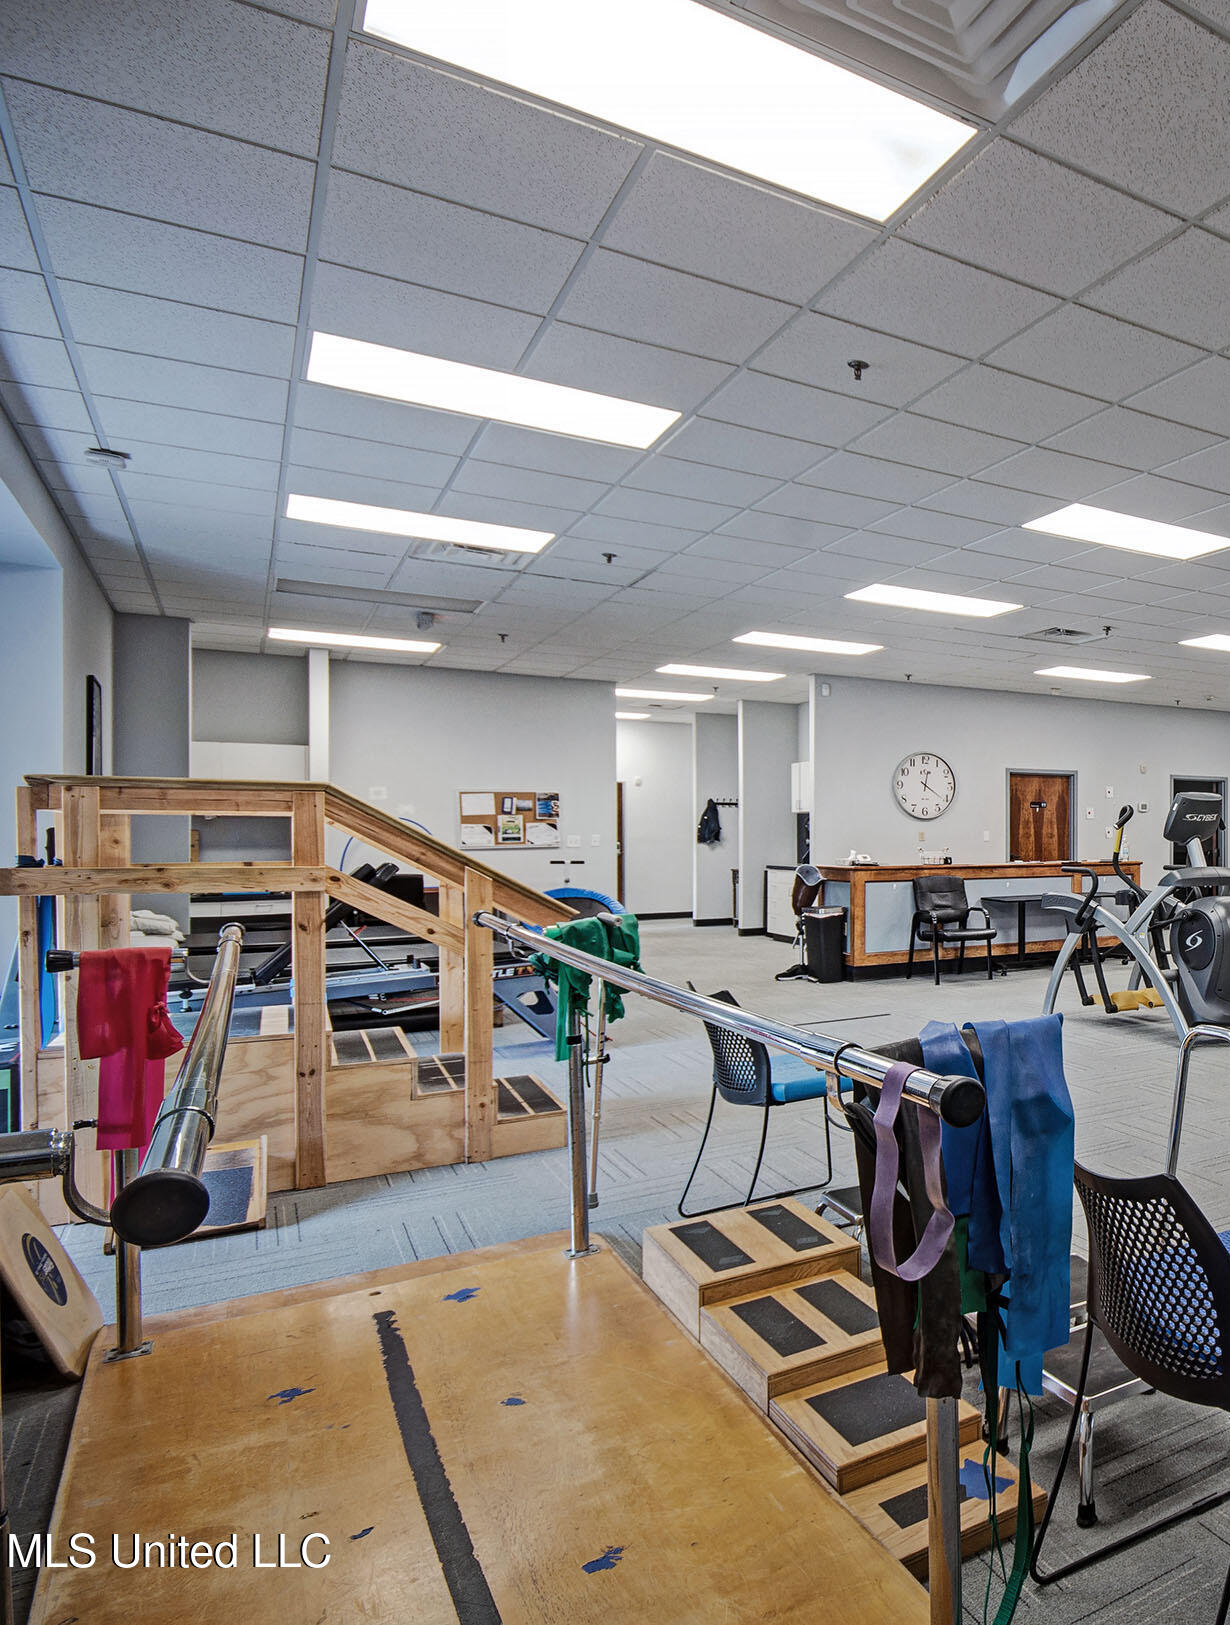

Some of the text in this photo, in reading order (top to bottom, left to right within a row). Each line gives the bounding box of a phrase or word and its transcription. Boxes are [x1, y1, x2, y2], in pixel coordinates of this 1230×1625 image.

[909, 758, 915, 767] 11
[921, 755, 930, 765] 12
[900, 767, 909, 777] 10
[896, 779, 904, 790] 9
[911, 803, 917, 813] 7
[921, 806, 929, 817] 6
